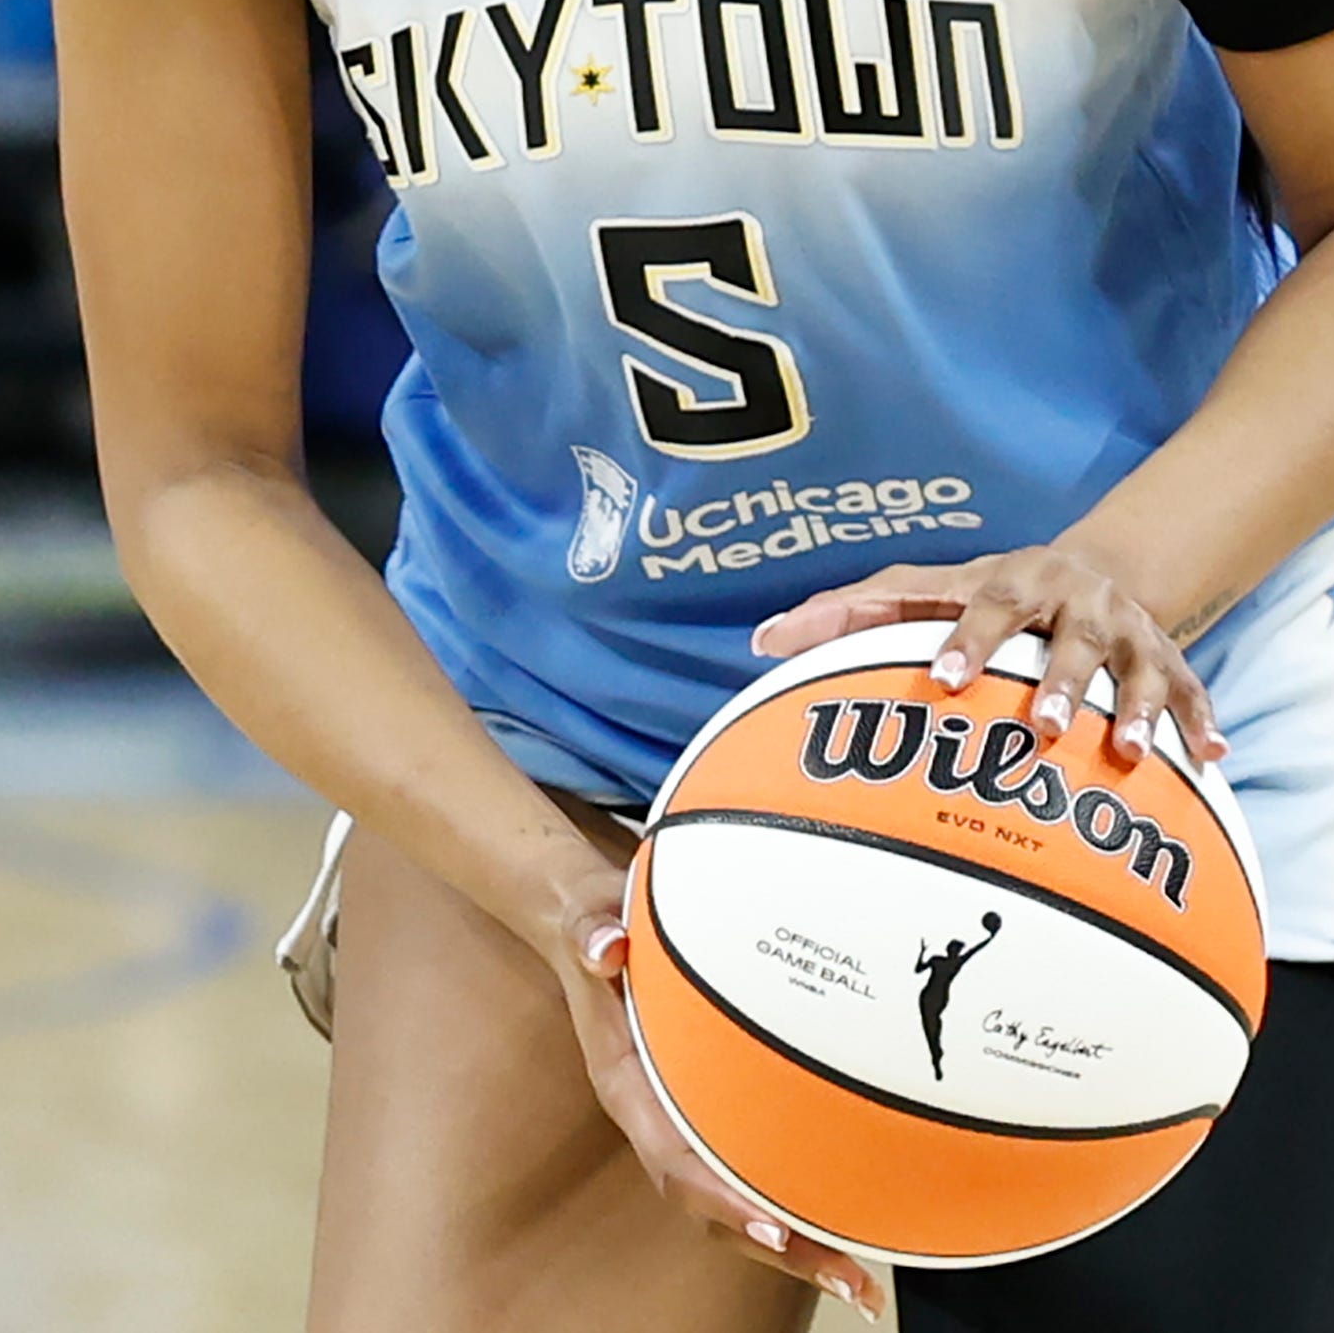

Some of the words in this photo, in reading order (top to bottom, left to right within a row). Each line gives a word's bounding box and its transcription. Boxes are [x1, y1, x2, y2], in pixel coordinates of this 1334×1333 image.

[589, 210, 814, 462] 5
[640, 511, 984, 580] Medicine
[797, 697, 1194, 913] Wilson
[936, 810, 985, 834] EVO
[994, 826, 1044, 852] NXT
[756, 939, 816, 976] GAME
[819, 966, 876, 1001] BALL
[774, 926, 867, 976] OFFICIAL
